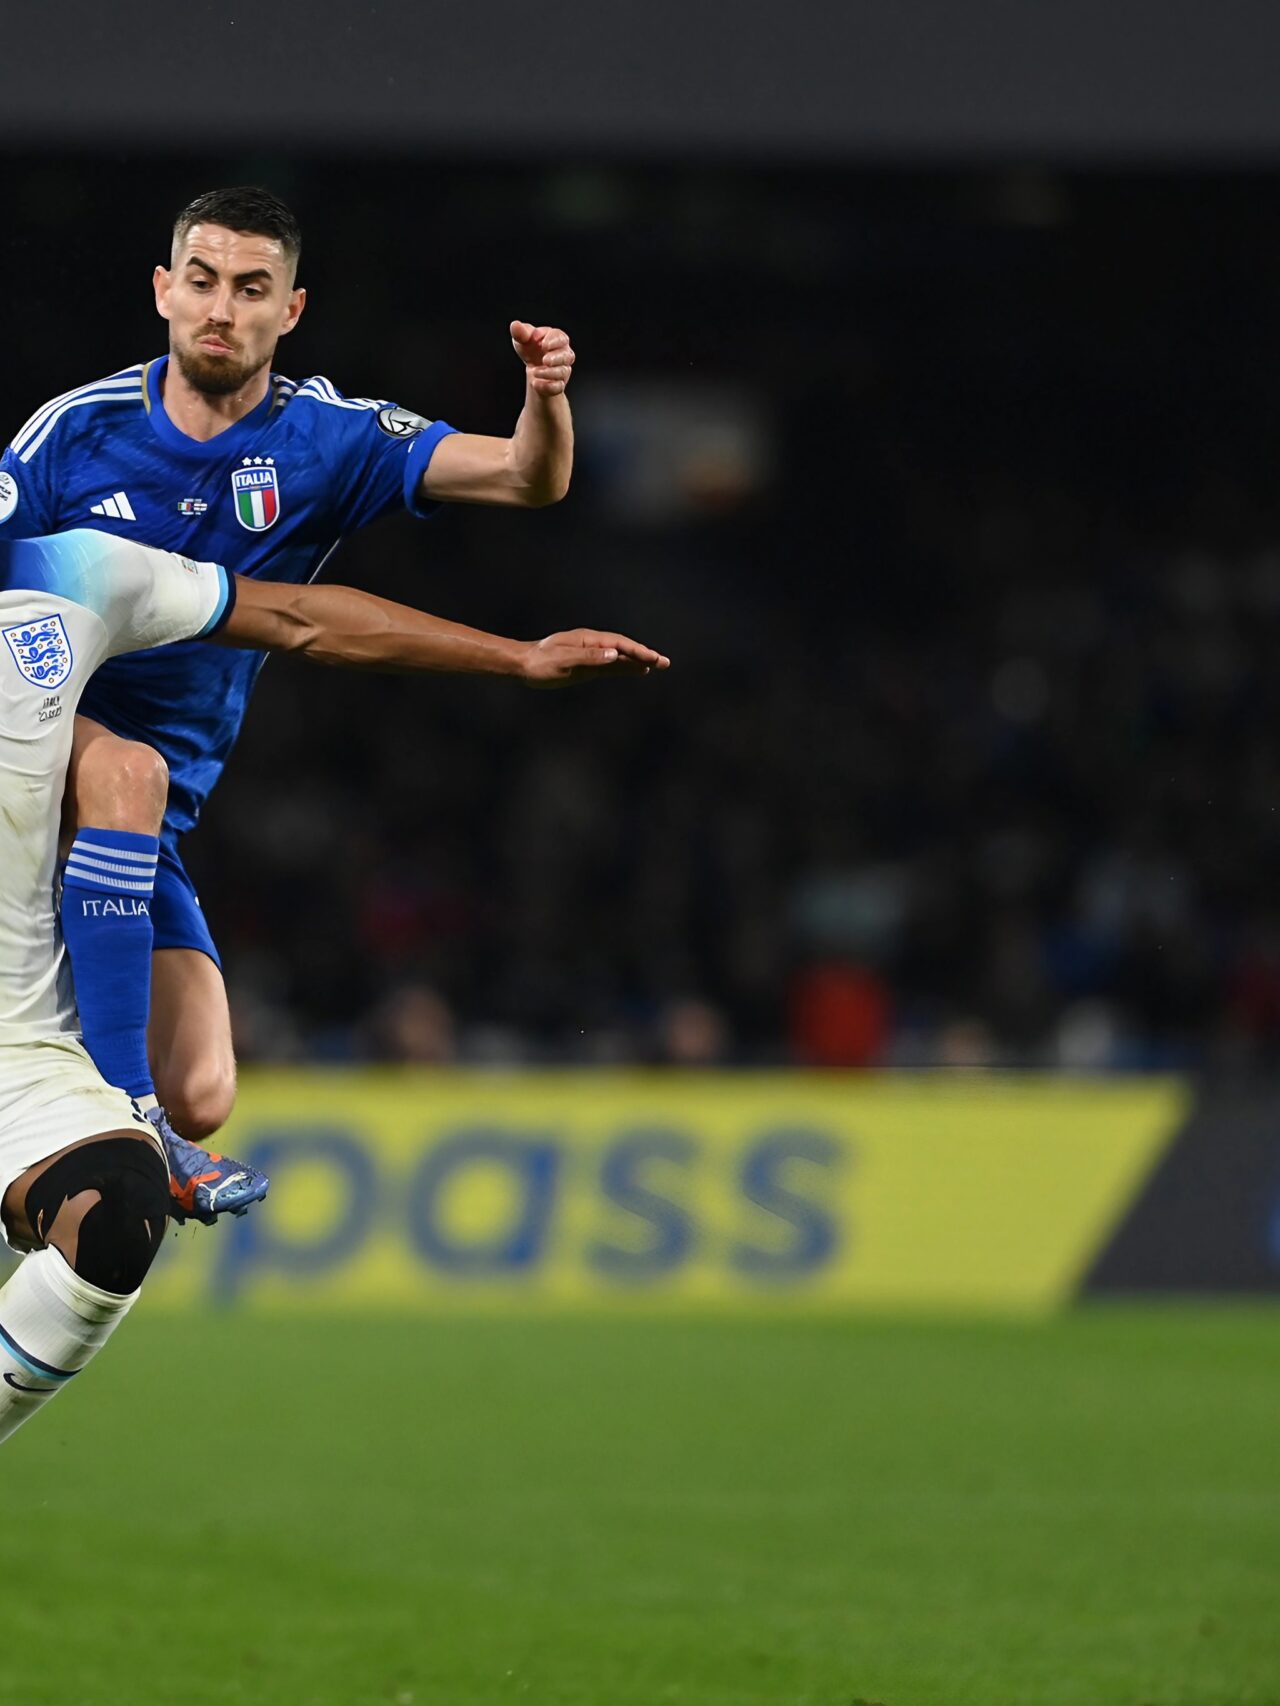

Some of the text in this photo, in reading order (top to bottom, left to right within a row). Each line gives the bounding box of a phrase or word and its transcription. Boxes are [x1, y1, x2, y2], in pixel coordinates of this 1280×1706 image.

[235, 472, 273, 488] ITALIA
[82, 898, 149, 917] ITALIA
[150, 1124, 848, 1308] pass
